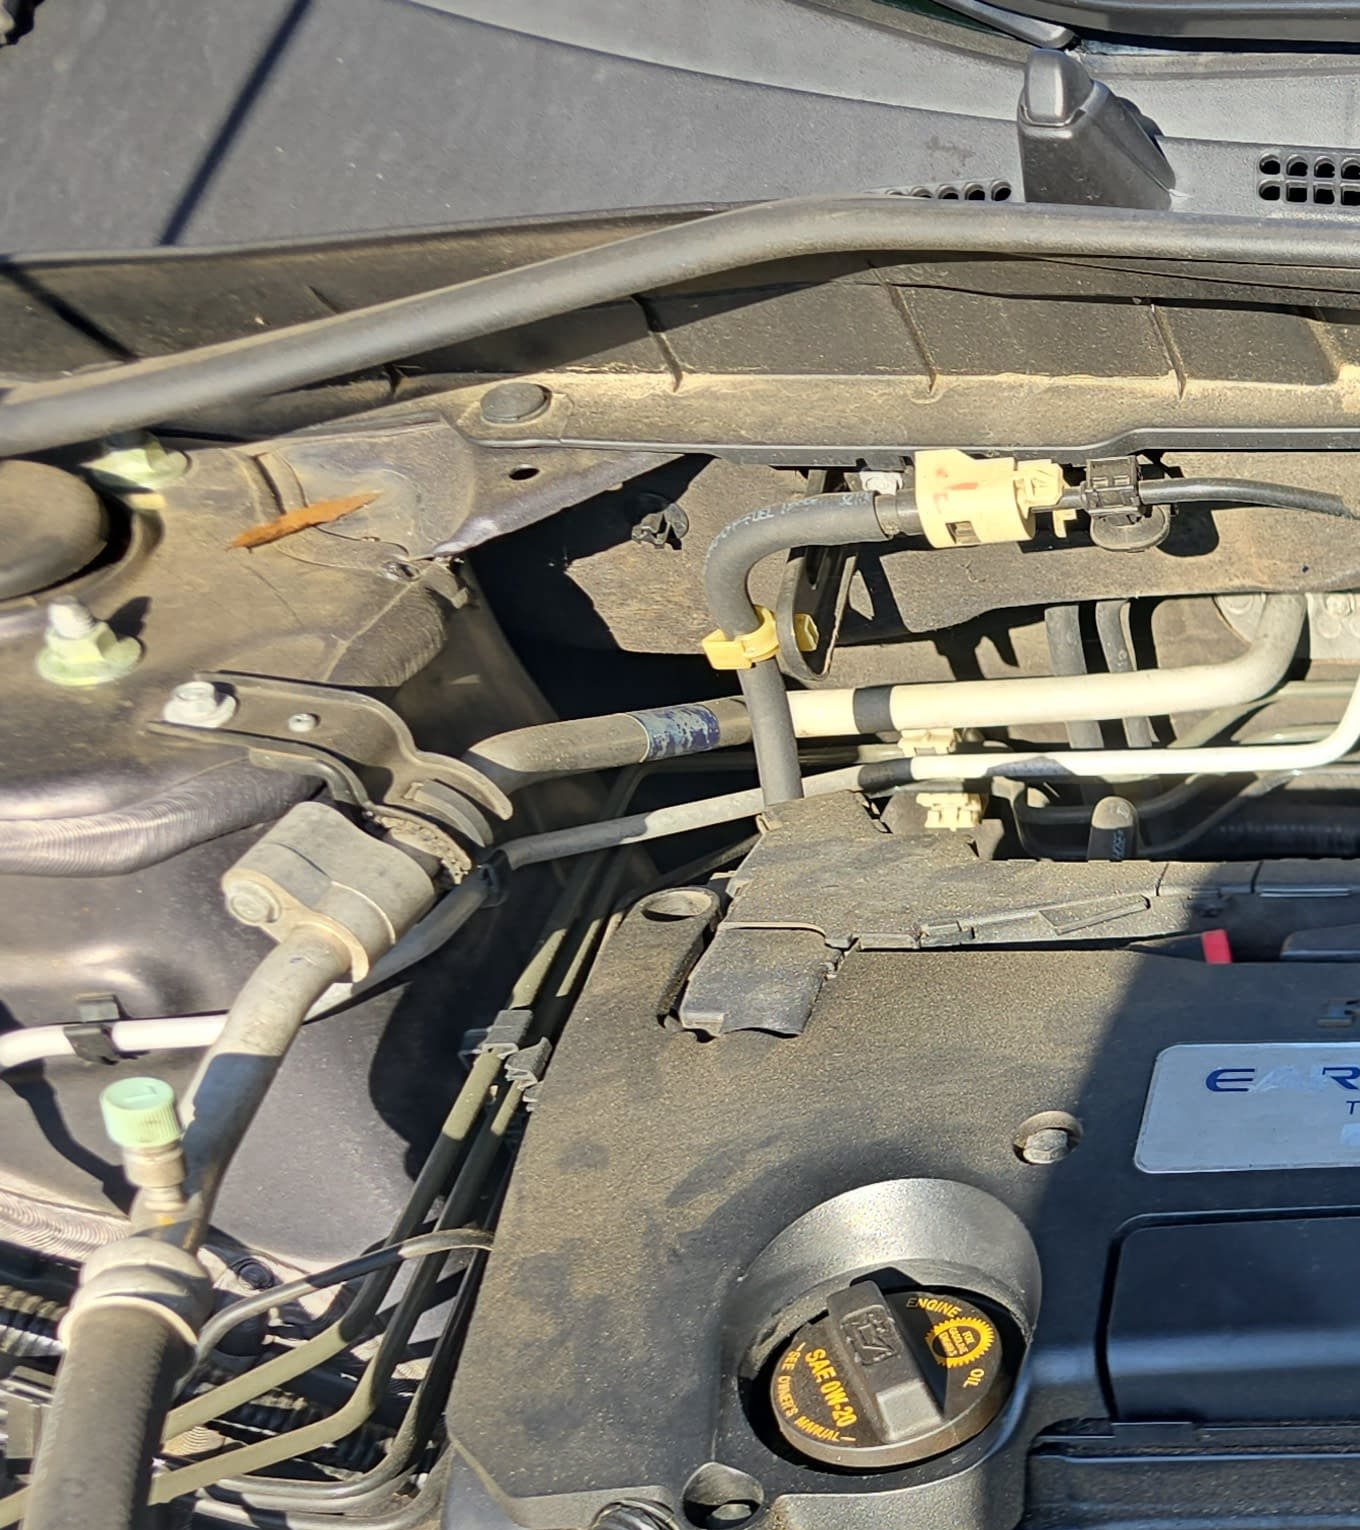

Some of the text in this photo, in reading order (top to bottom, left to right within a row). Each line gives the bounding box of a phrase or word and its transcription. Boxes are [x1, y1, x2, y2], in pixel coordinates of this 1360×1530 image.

[906, 1296, 962, 1318] ENGINE
[804, 1348, 837, 1383] SAE
[962, 1368, 985, 1388] OIL
[781, 1351, 801, 1371] SEE
[793, 1415, 841, 1443] MANUAL
